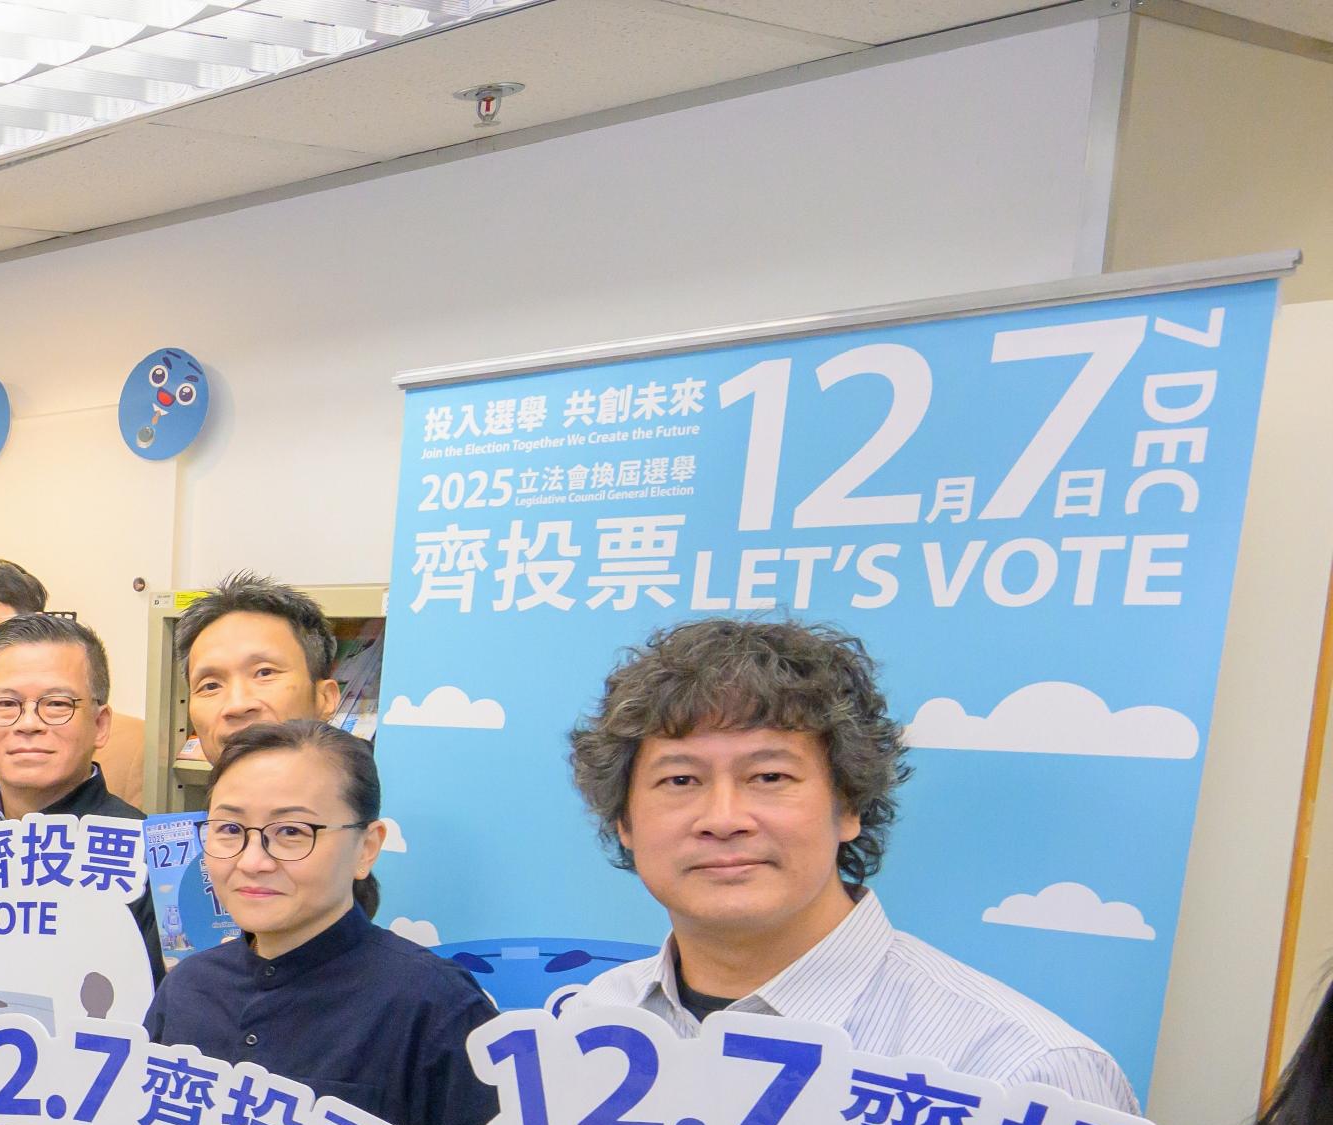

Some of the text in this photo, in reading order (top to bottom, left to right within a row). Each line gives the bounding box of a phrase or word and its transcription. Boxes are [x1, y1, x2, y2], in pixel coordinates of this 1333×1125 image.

[421, 423, 700, 460] Join the Election Together We Create the Future
[423, 377, 706, 442] 投入選舉 共創未來
[1125, 370, 1218, 515] DEC
[515, 485, 694, 508] Legislative Council General Election
[410, 514, 686, 614] 齊投票
[923, 534, 1190, 607] VOTE
